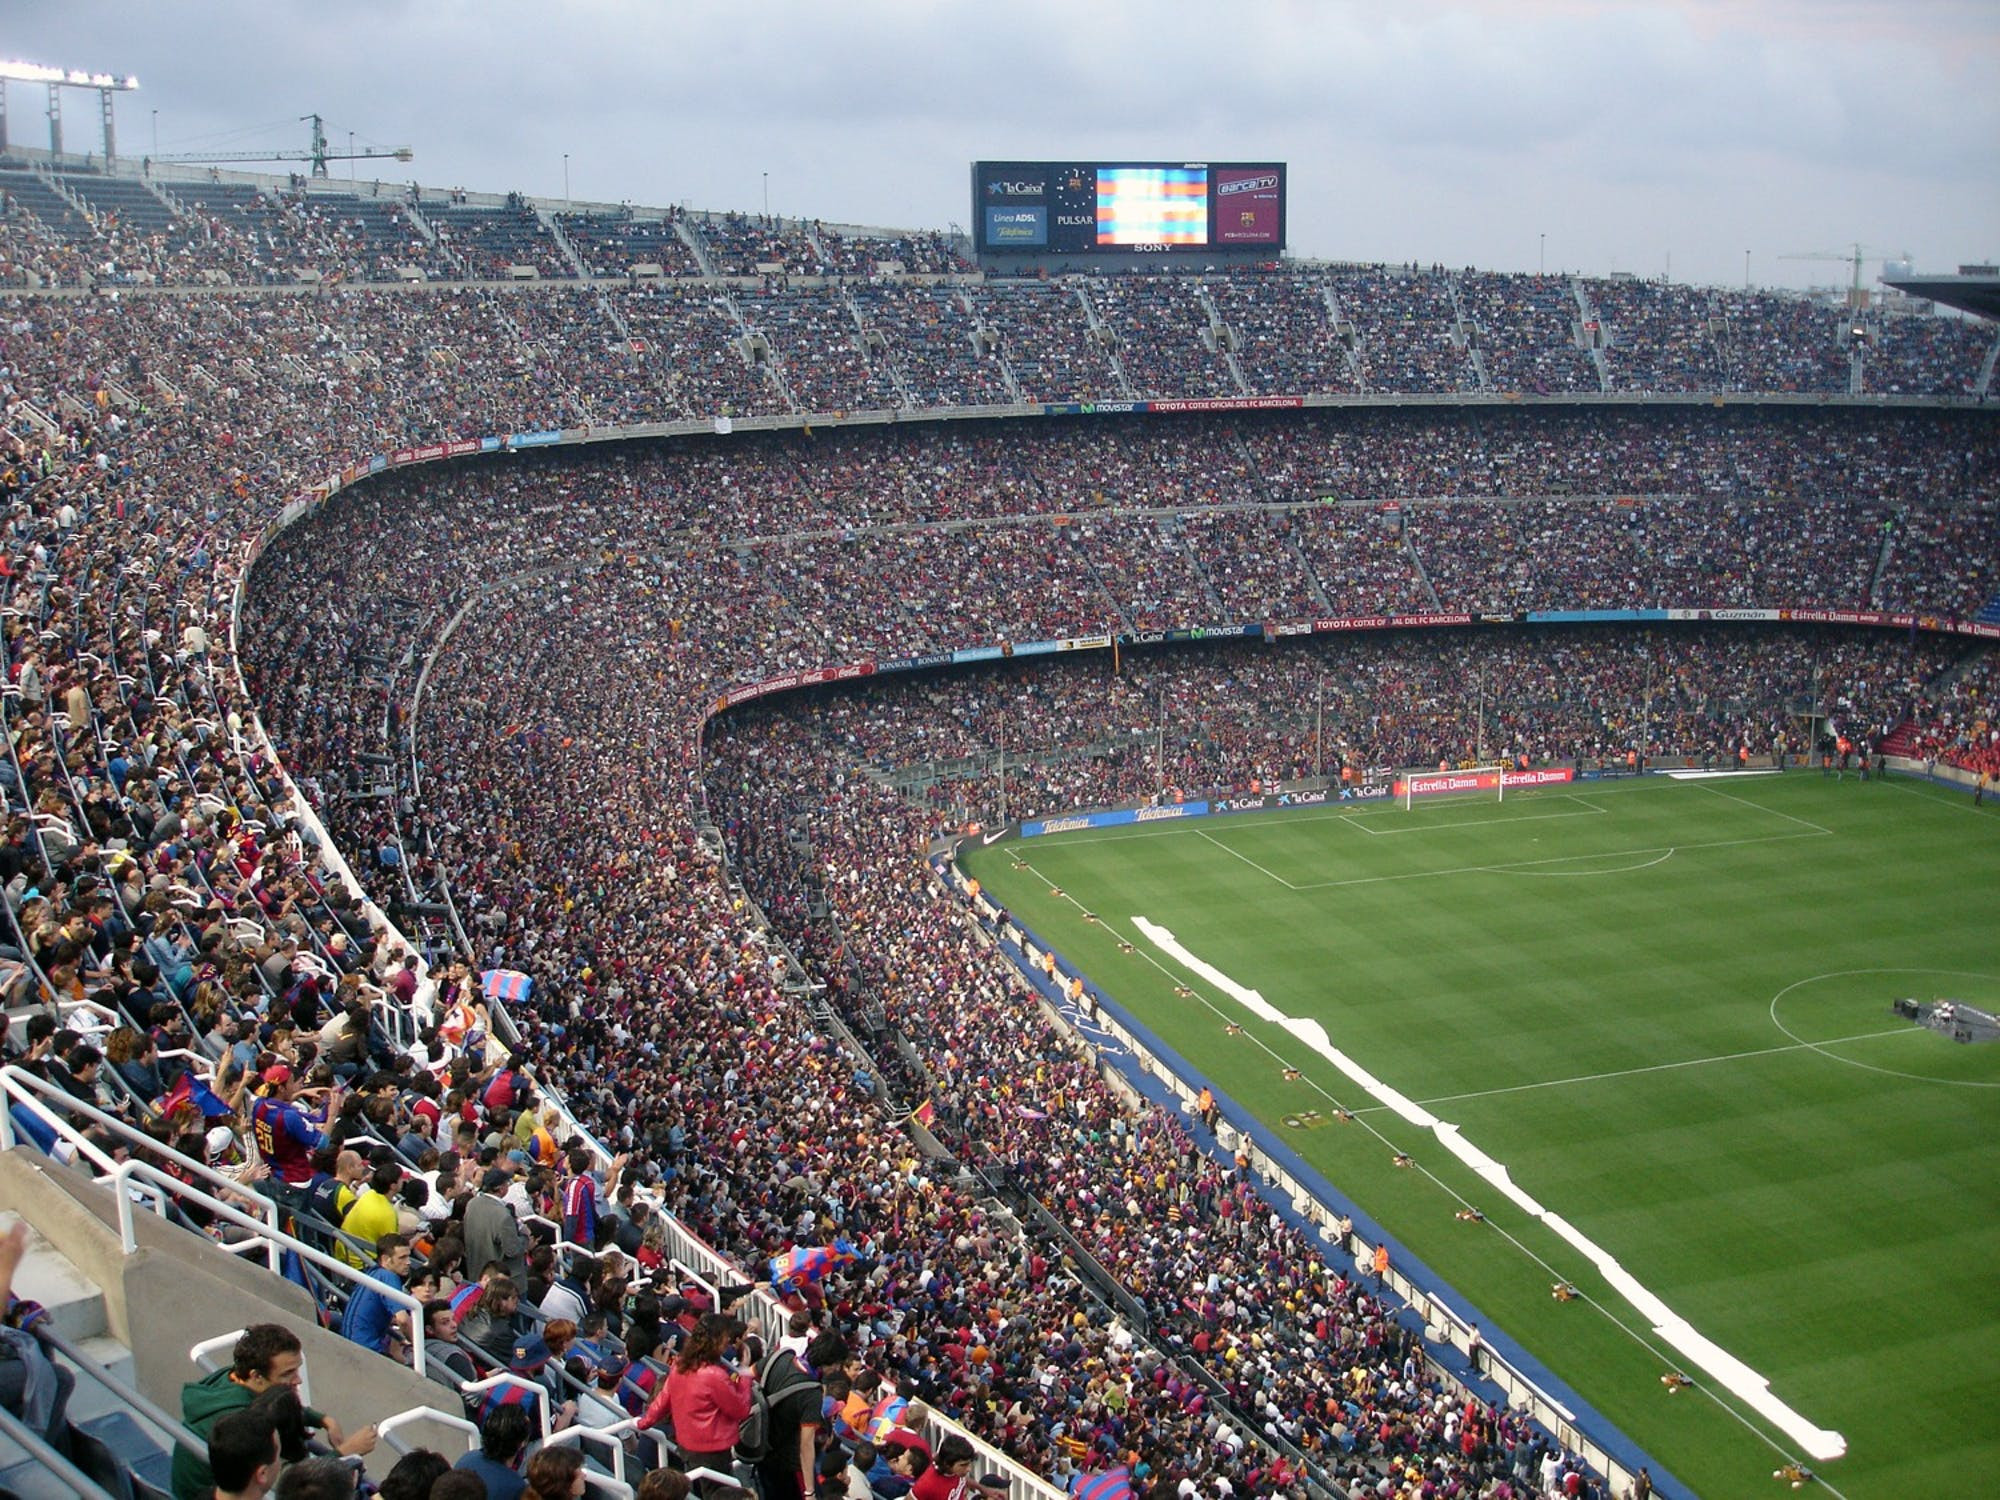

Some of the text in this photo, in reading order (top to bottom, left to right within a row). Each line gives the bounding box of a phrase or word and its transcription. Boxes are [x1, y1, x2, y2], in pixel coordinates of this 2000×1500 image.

[1015, 214, 1036, 222] ADSL
[1058, 216, 1093, 225] PULSAR
[1134, 244, 1172, 252] SONY
[1317, 621, 1351, 629] TOYOTA
[1404, 617, 1417, 625] DEL
[1206, 626, 1245, 636] movistar
[1502, 772, 1537, 785] Estrella
[1538, 769, 1566, 782] Damm
[1412, 778, 1478, 792] Estrella Damm
[255, 1128, 274, 1154] 20
